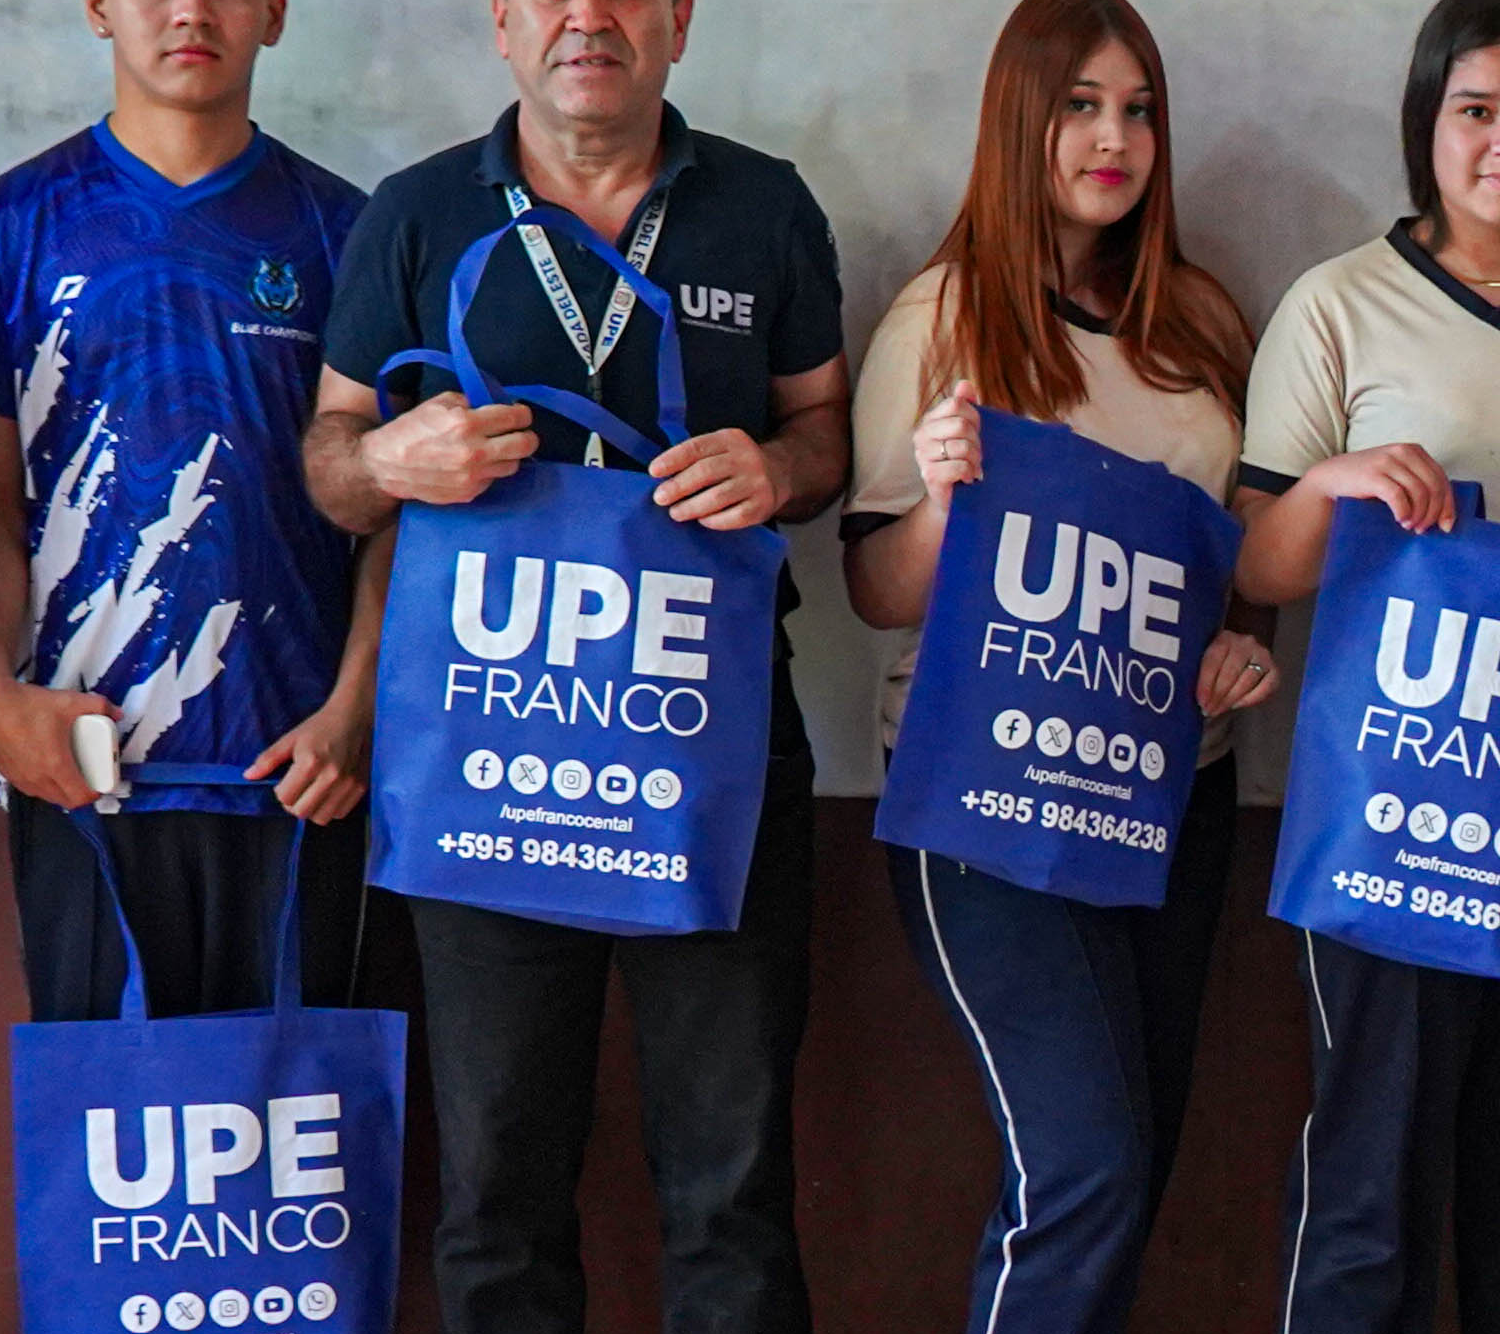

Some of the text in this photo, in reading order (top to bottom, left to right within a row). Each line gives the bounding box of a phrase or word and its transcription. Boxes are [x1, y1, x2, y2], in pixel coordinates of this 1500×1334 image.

[601, 313, 624, 348] UPE
[679, 283, 755, 327] UPE
[452, 550, 714, 680] UPE
[993, 511, 1185, 663] UPE
[444, 663, 710, 737] FRANCO
[980, 622, 1176, 714] FRANCO
[961, 789, 1168, 854] +595 984364238
[436, 831, 689, 884] +595 984364238
[1331, 869, 1404, 908] +595
[85, 1093, 346, 1210] UPE
[92, 1201, 352, 1264] FRANCO
